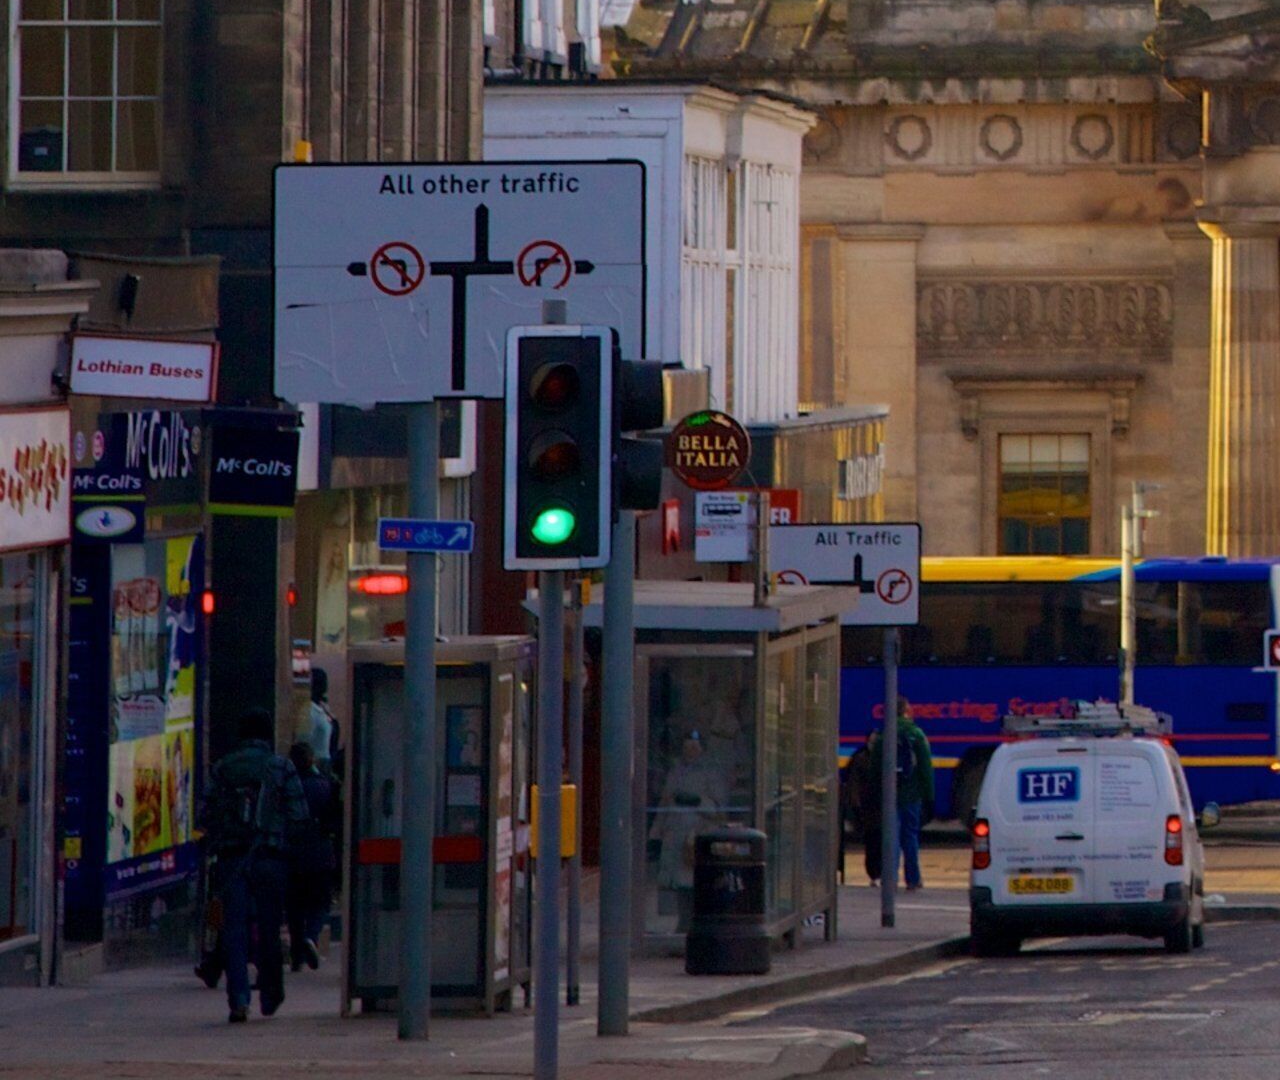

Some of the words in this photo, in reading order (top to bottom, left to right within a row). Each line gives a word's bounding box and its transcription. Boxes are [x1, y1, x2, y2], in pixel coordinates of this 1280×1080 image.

[379, 173, 414, 195] All
[422, 174, 491, 194] other
[500, 172, 580, 193] traffic
[77, 359, 144, 376] Lothian
[149, 362, 204, 380] Buses
[678, 435, 738, 450] BELLA
[676, 452, 740, 467] ITALIA
[815, 531, 838, 546] All
[846, 531, 901, 546] Traffic
[872, 699, 998, 722] cnecting
[1024, 772, 1073, 798] HF
